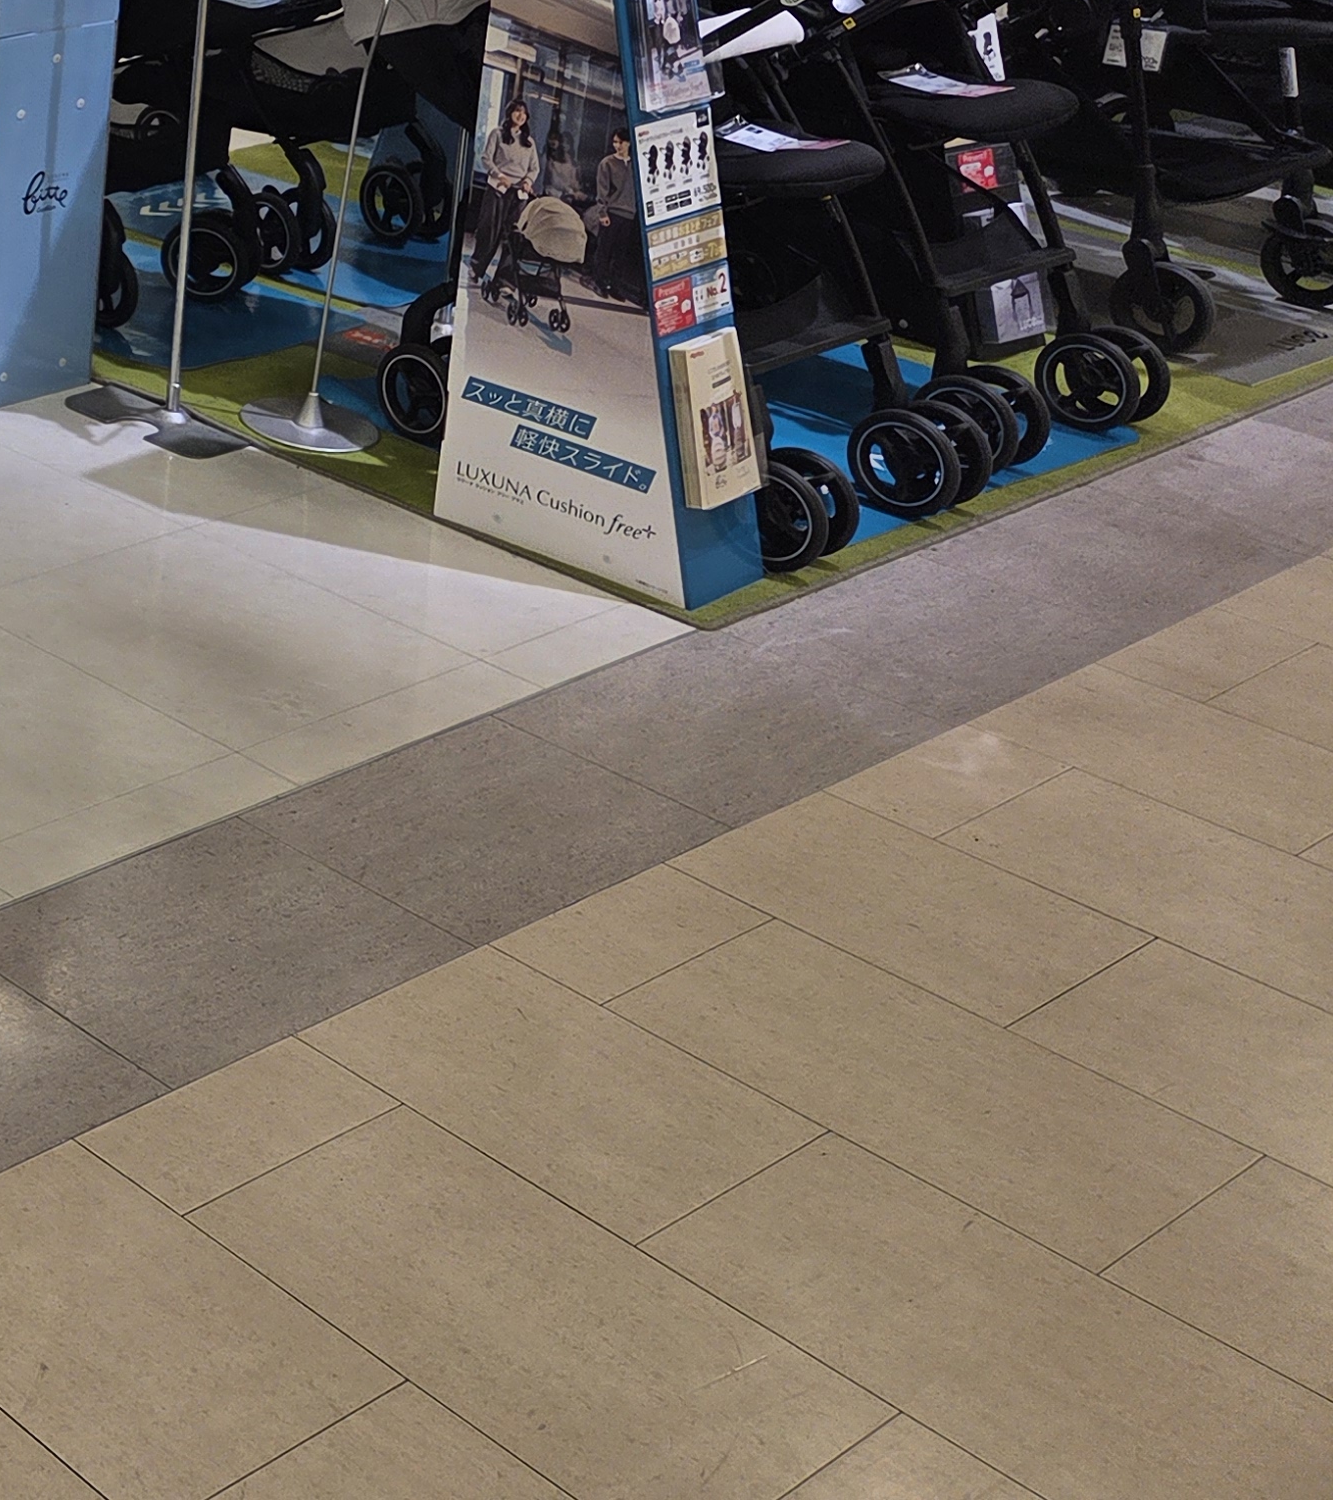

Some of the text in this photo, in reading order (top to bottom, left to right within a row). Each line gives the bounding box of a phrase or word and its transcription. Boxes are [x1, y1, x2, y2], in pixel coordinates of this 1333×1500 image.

[465, 380, 593, 436] スッと真横に
[515, 426, 649, 491] 軽快スライド。
[457, 461, 532, 500] LUXUNA
[536, 490, 605, 526] Cushion
